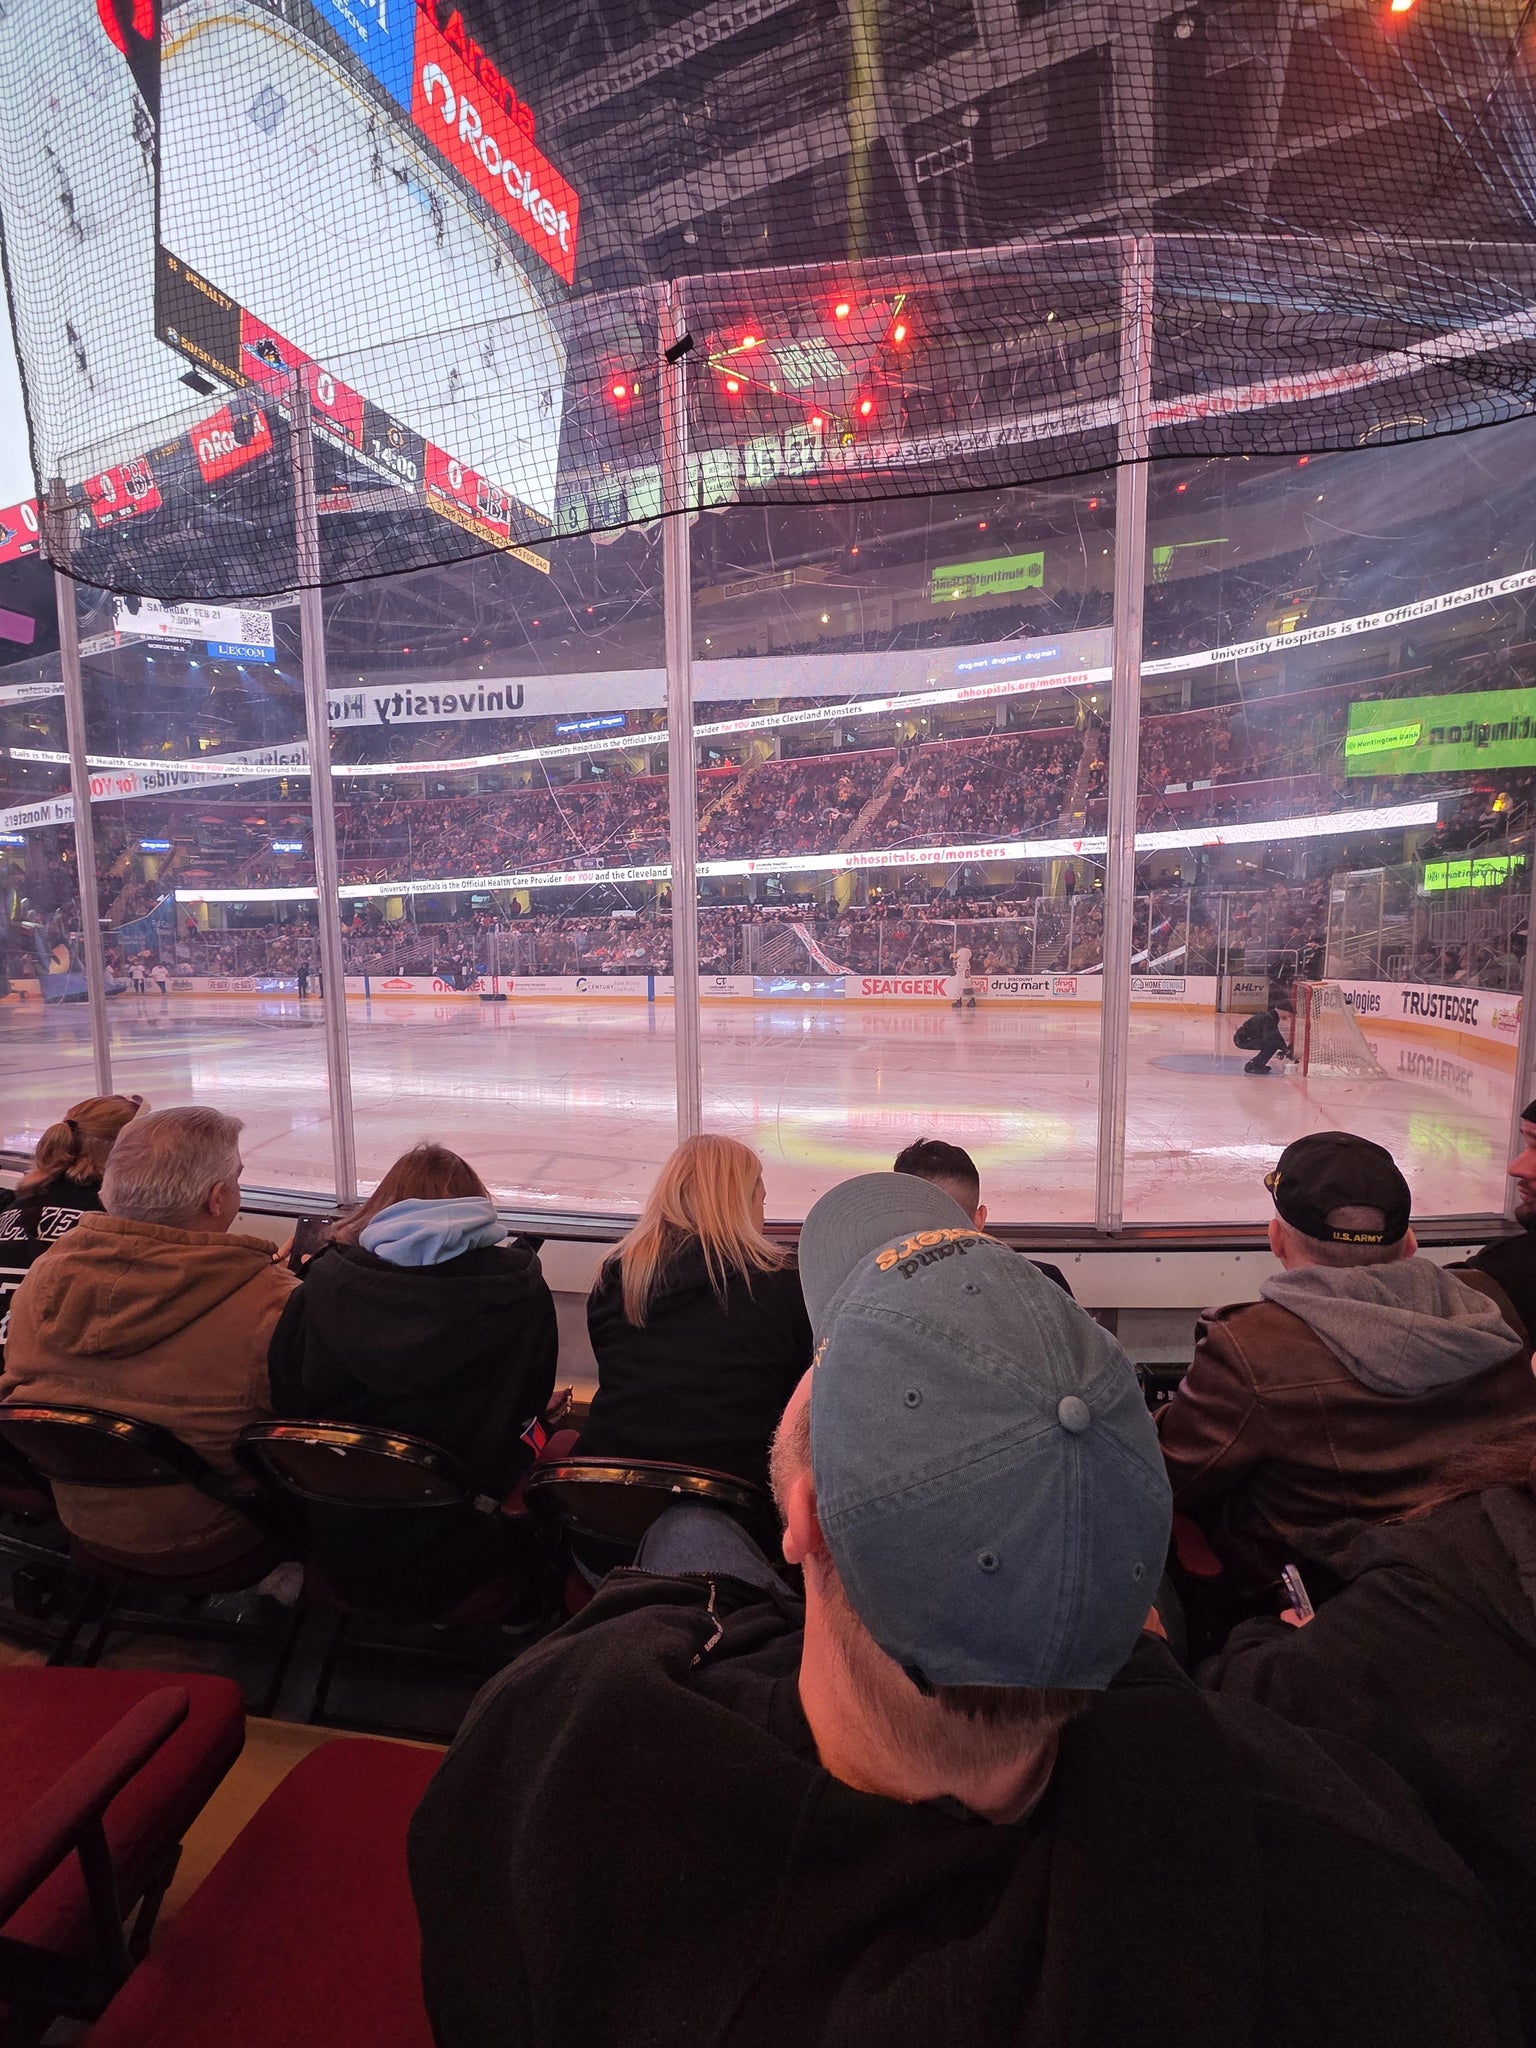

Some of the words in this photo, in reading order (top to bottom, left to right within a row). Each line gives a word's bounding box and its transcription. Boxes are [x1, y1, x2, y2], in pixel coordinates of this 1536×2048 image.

[442, 8, 536, 145] Arena
[458, 95, 571, 253] Rocket
[185, 270, 233, 311] PENALTY
[317, 372, 336, 406] 0
[372, 439, 417, 481] 14:00
[447, 460, 463, 490] 0
[20, 503, 38, 532] 0
[522, 550, 536, 563] FOR
[194, 608, 209, 618] FEB
[212, 610, 221, 620] 21
[1211, 639, 1273, 662] University
[1275, 623, 1337, 647] Hospitals
[1341, 623, 1352, 634] is
[1356, 618, 1380, 631] the
[1384, 600, 1438, 623] Official
[1442, 585, 1494, 608] Health
[1500, 574, 1536, 592] Care
[218, 645, 266, 658] LECOM
[957, 672, 1089, 699] uhhospitals.org/monsters
[539, 747, 571, 757] University
[572, 743, 602, 753] Hospitals
[603, 741, 609, 749] is
[610, 739, 621, 749] the
[622, 735, 647, 746] Official
[722, 723, 733, 731] for
[734, 721, 749, 729] YOU
[750, 718, 765, 728] and
[767, 715, 780, 725] the
[782, 710, 822, 723] Cleveland
[823, 705, 862, 717] Monsters
[1357, 736, 1398, 748] Huntington
[42, 752, 54, 761] the
[97, 758, 126, 767] Health
[127, 760, 148, 768] Care
[150, 761, 188, 771] Provider
[191, 762, 204, 771] for
[205, 763, 224, 772] YOU
[242, 766, 254, 774] the
[256, 766, 290, 774] Cleveland
[845, 846, 1006, 867] uhhospitals.org/monsters
[380, 884, 410, 894] University
[412, 881, 441, 892] Hospitals
[442, 881, 448, 890] is
[449, 881, 460, 890] the
[461, 878, 487, 888] Official
[488, 877, 511, 887] Health
[512, 876, 529, 886] Care
[530, 874, 562, 885] Provider
[564, 872, 575, 882] for
[578, 871, 594, 882] YOU
[595, 871, 609, 881] and
[612, 870, 625, 880] the
[627, 867, 668, 878] Cleveland
[861, 978, 948, 996] SEATGEEK
[991, 980, 1019, 993] drug
[1020, 980, 1050, 990] mart
[1055, 979, 1073, 987] drug
[1401, 990, 1479, 1026] TRUSTEDSEC
[1333, 1231, 1352, 1242] U.S.
[1353, 1232, 1385, 1243] ARMY
